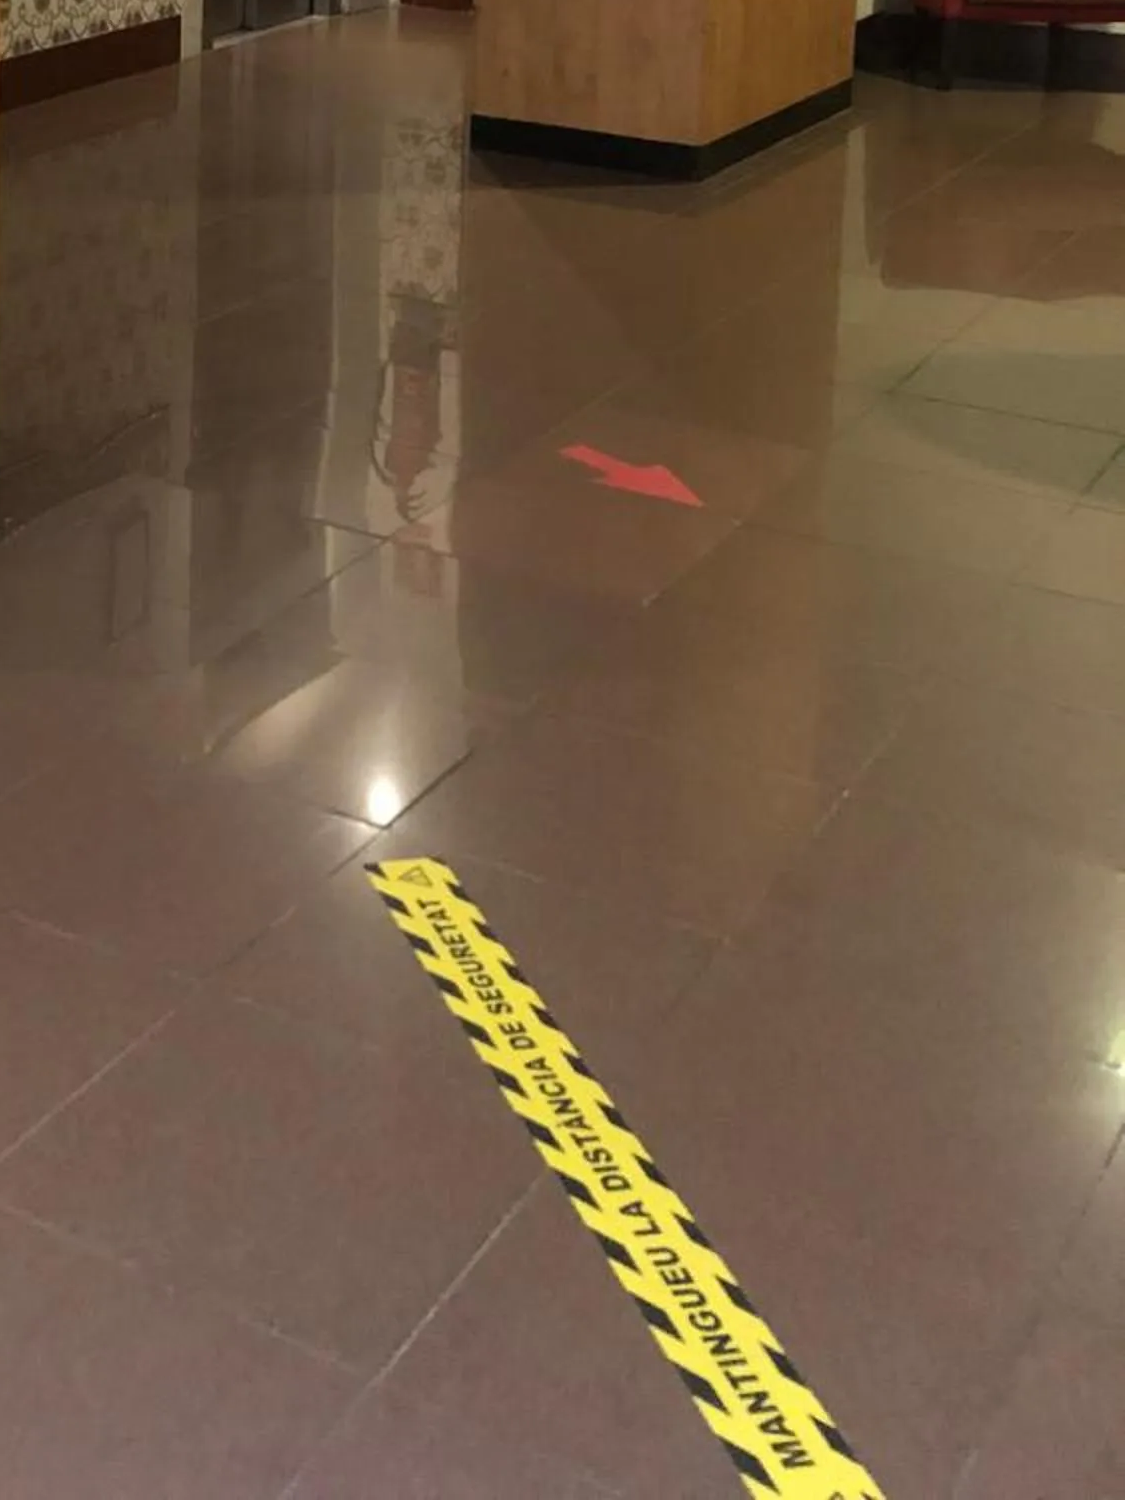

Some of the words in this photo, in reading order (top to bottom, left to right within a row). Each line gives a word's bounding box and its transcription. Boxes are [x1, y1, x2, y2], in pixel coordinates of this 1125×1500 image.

[416, 898, 514, 1015] SEGURETAT
[498, 1019, 536, 1051] DE
[618, 1200, 662, 1237] LA
[644, 1246, 816, 1470] MANTINGUEU
